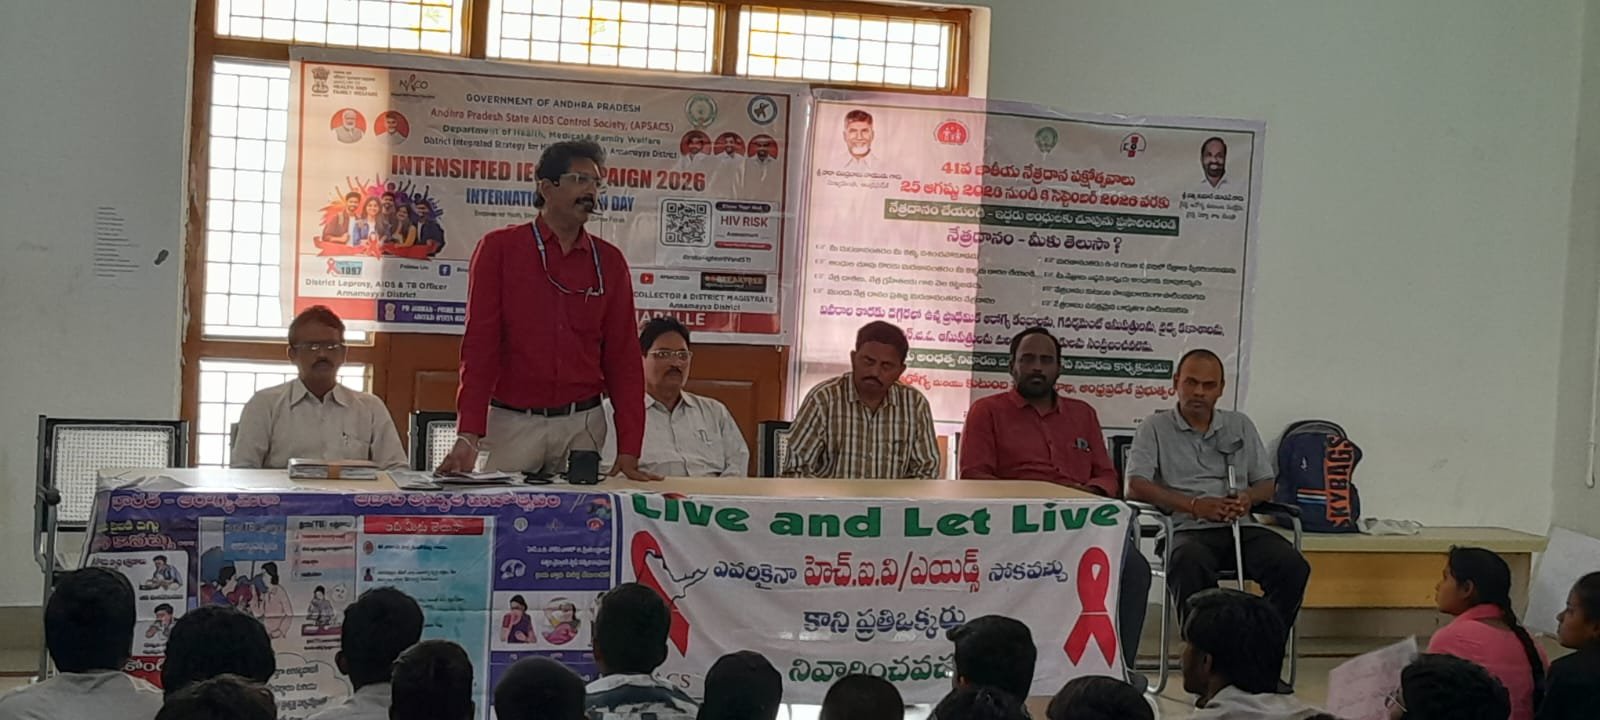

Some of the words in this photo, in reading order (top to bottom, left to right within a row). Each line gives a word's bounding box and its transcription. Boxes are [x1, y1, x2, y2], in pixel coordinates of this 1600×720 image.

[466, 93, 533, 106] GOVERNMENT
[537, 98, 550, 107] OF
[553, 99, 594, 110] ANDHRA
[597, 102, 641, 113] PRADESH
[431, 107, 465, 119] Andhra
[467, 110, 503, 121] Pradesh
[506, 113, 530, 123] State
[532, 114, 554, 126] AIDS
[557, 116, 591, 128] Control
[593, 118, 628, 131] Society,
[630, 121, 674, 133] (APSACS)
[502, 127, 512, 136] of
[392, 155, 511, 180] INTENSIFIED
[656, 169, 706, 192] 2026
[975, 163, 1020, 179] జాతీయ
[1022, 163, 1069, 184] నేత్రదాన
[900, 181, 921, 194] 25
[1005, 186, 1038, 201] నుండి
[611, 195, 635, 212] DAY
[888, 201, 939, 218] నేత్రదానం
[721, 215, 741, 226] HIV
[742, 216, 769, 228] RISK
[947, 226, 1015, 247] నేత్రదానం
[1028, 232, 1061, 249] మీకు
[1064, 234, 1111, 251] తెలుసా
[305, 278, 336, 286] District
[338, 279, 372, 289] Leprosy,
[375, 280, 397, 289] AIDS
[406, 281, 418, 289] TB
[419, 281, 448, 290] Officer
[387, 290, 417, 299] District
[634, 291, 681, 300] COLLECTOR
[690, 293, 724, 301] DISTRICT
[713, 303, 740, 311] District
[632, 492, 750, 532] Live
[769, 506, 882, 538] and
[904, 506, 991, 537] Let
[1012, 502, 1121, 534] Live
[713, 560, 797, 590] ఎవరికైనా
[988, 559, 1069, 583] సోకవచ్చు
[803, 610, 850, 633] కాని
